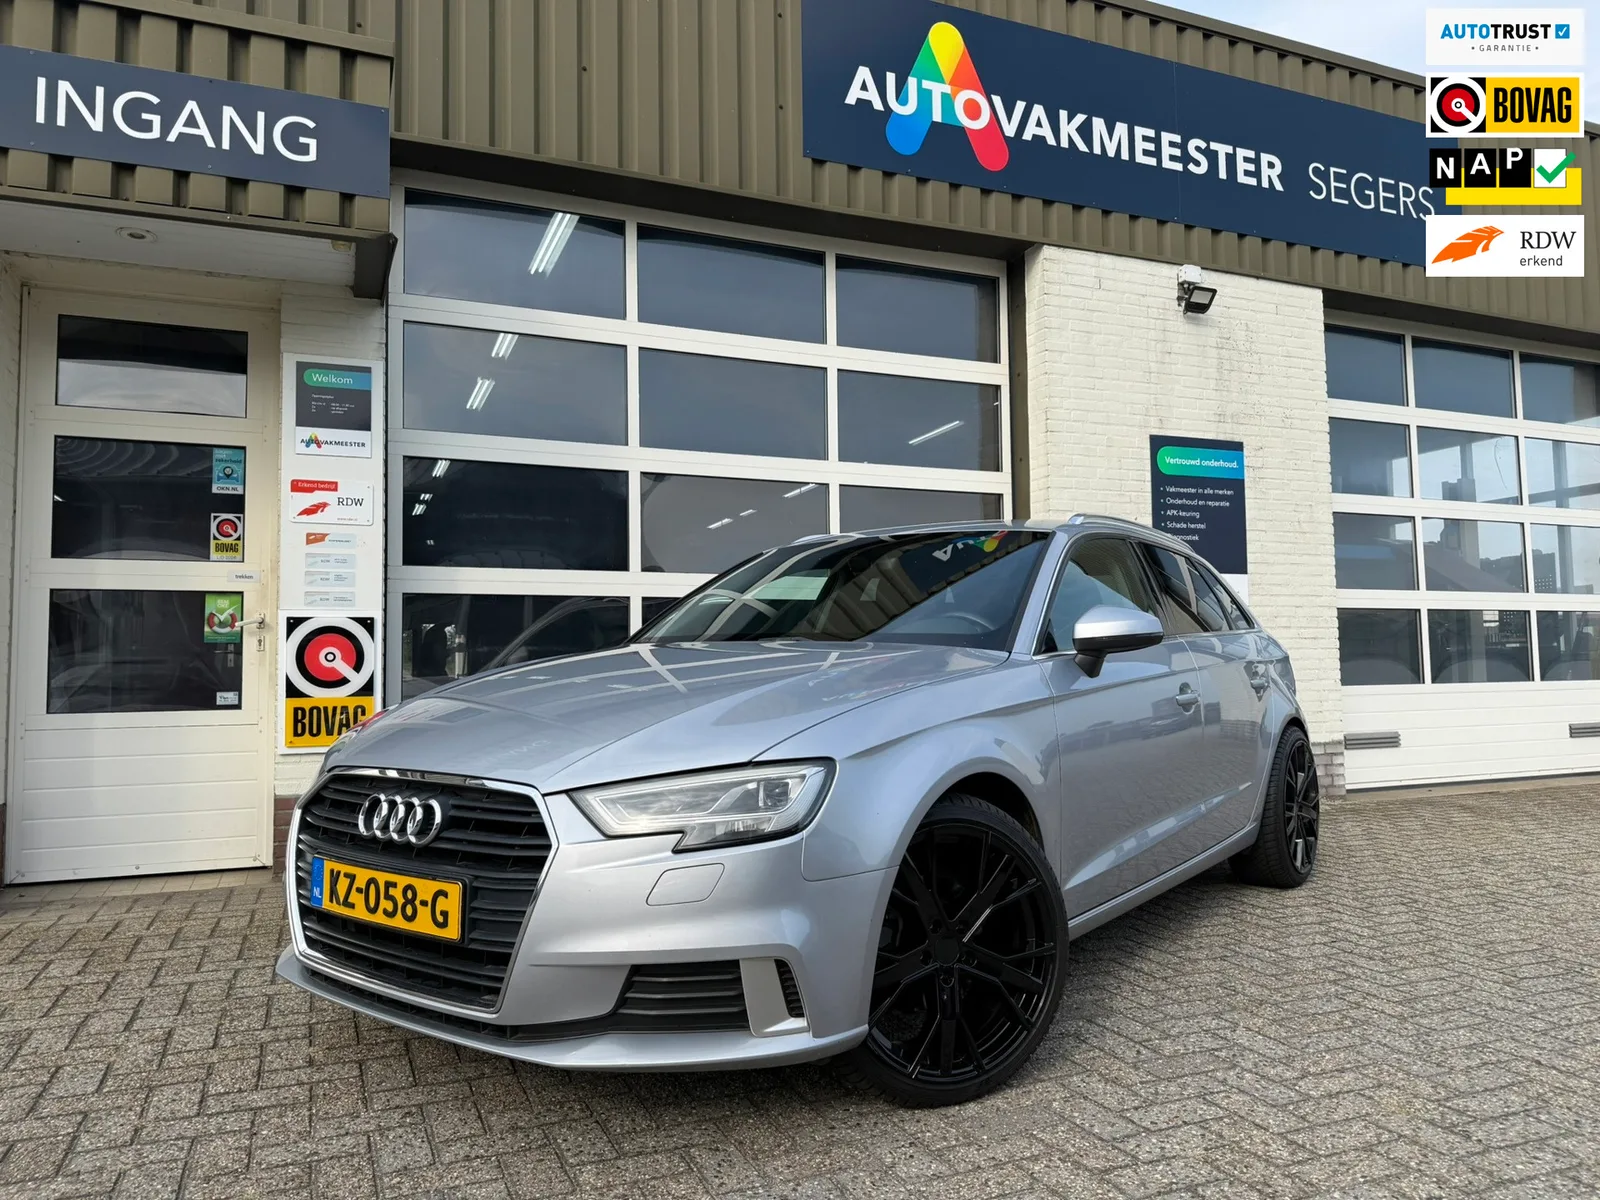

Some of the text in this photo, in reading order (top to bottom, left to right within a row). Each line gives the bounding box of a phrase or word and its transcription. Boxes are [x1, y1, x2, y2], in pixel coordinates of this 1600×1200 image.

[35, 76, 318, 163] INGANG
[844, 65, 1436, 221] AUTOVAKMEESTER SEGERS
[311, 372, 353, 385] Welkom
[300, 438, 366, 448] AUTOVAKMEESTER
[1165, 456, 1239, 469] Vertrouwd onderhoud.
[1165, 486, 1197, 494] Vakmeester
[337, 497, 364, 506] RDW
[1165, 497, 1198, 505] Onderhoud
[1166, 509, 1200, 519] APK-keuring
[1166, 521, 1187, 529] Schade
[215, 542, 239, 553] BOVAG
[313, 867, 449, 930] NL KZ-058-G
